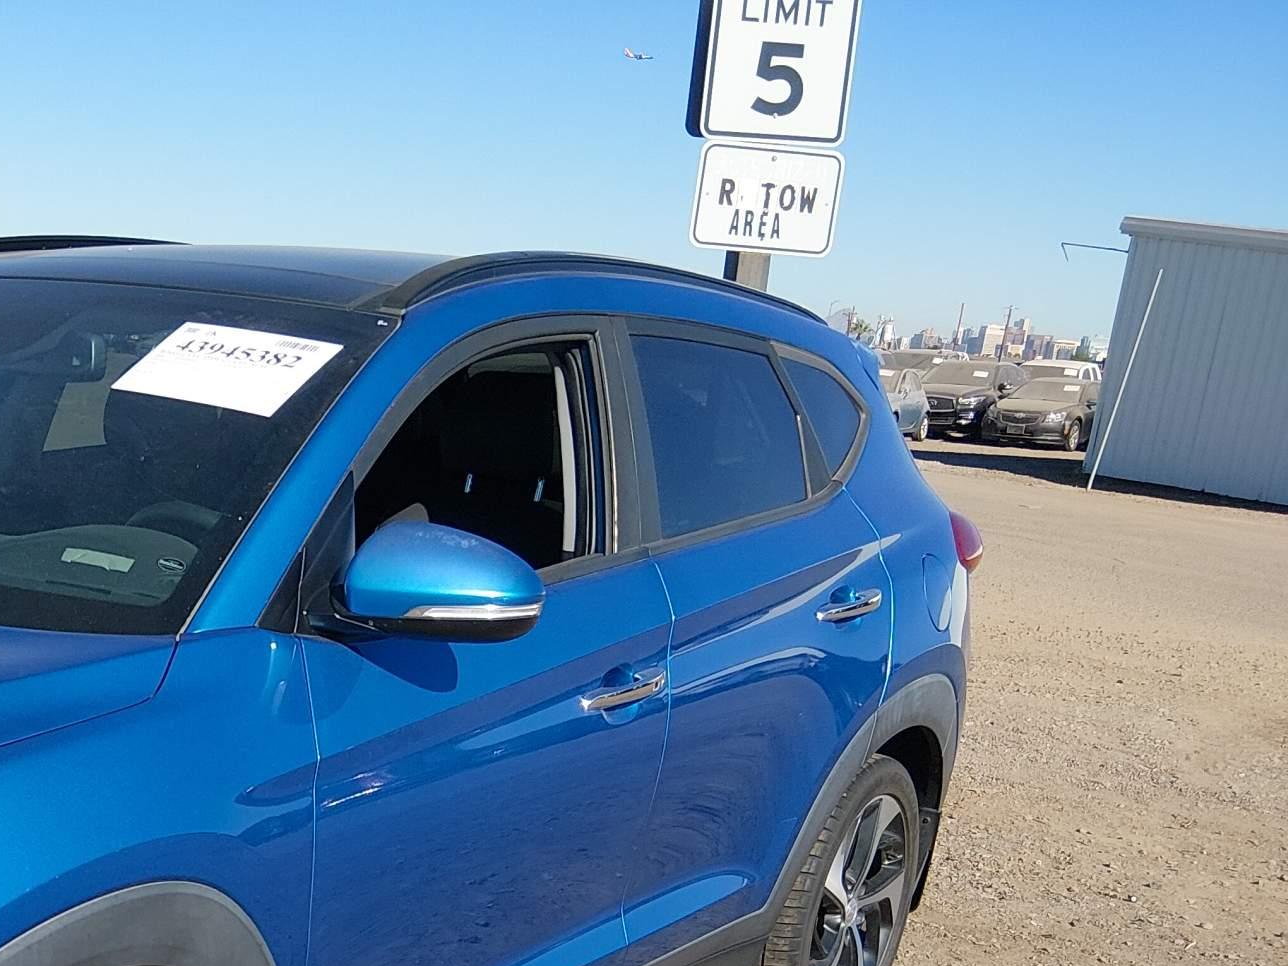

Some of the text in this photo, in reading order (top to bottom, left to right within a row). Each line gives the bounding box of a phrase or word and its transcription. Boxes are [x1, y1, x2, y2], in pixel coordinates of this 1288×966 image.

[741, 0, 833, 27] LIMIT
[750, 41, 805, 117] 5
[761, 182, 818, 214] TOW
[728, 208, 781, 239] AREA
[176, 339, 304, 369] 43945382
